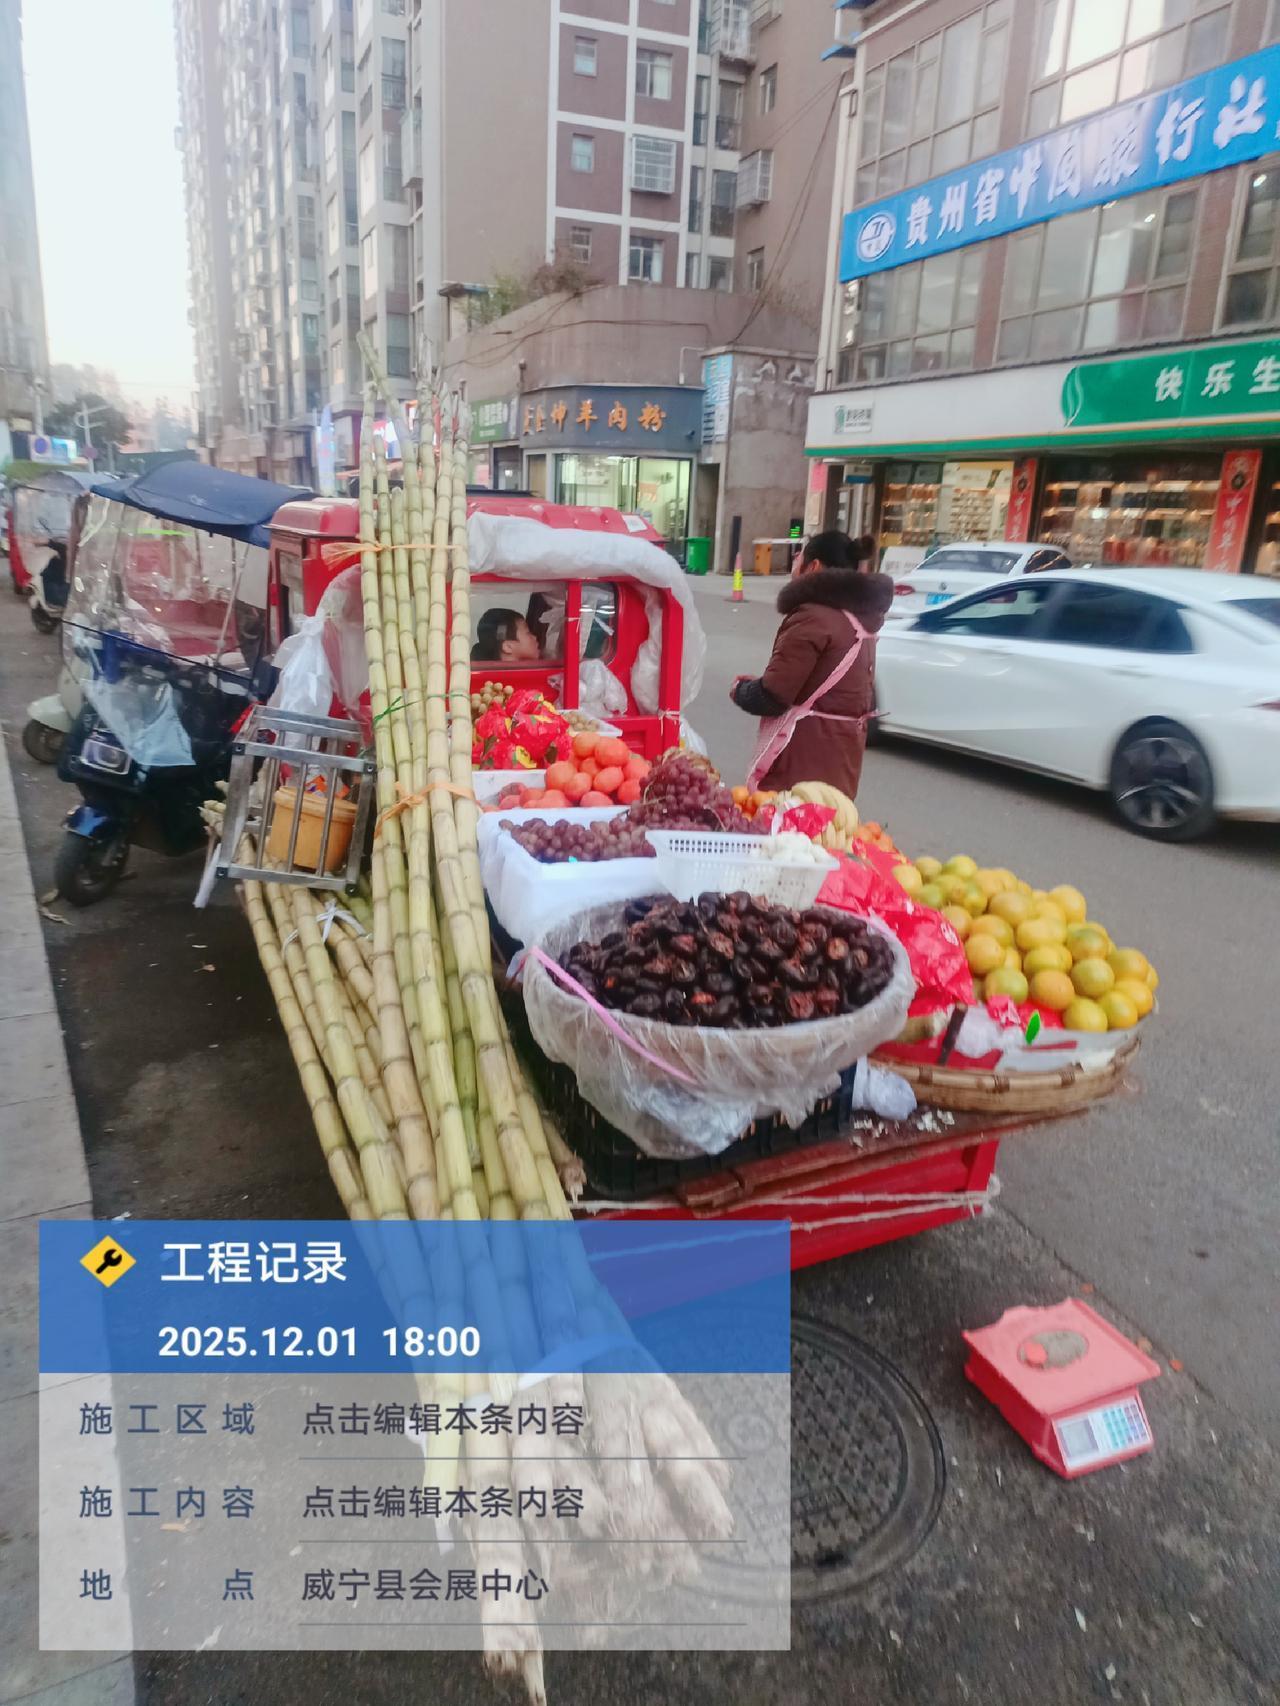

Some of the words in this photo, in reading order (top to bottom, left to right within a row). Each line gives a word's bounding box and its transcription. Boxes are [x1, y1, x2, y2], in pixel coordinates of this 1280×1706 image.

[903, 74, 1280, 250] 贵州省中国旅行社
[1154, 354, 1280, 403] 快乐生
